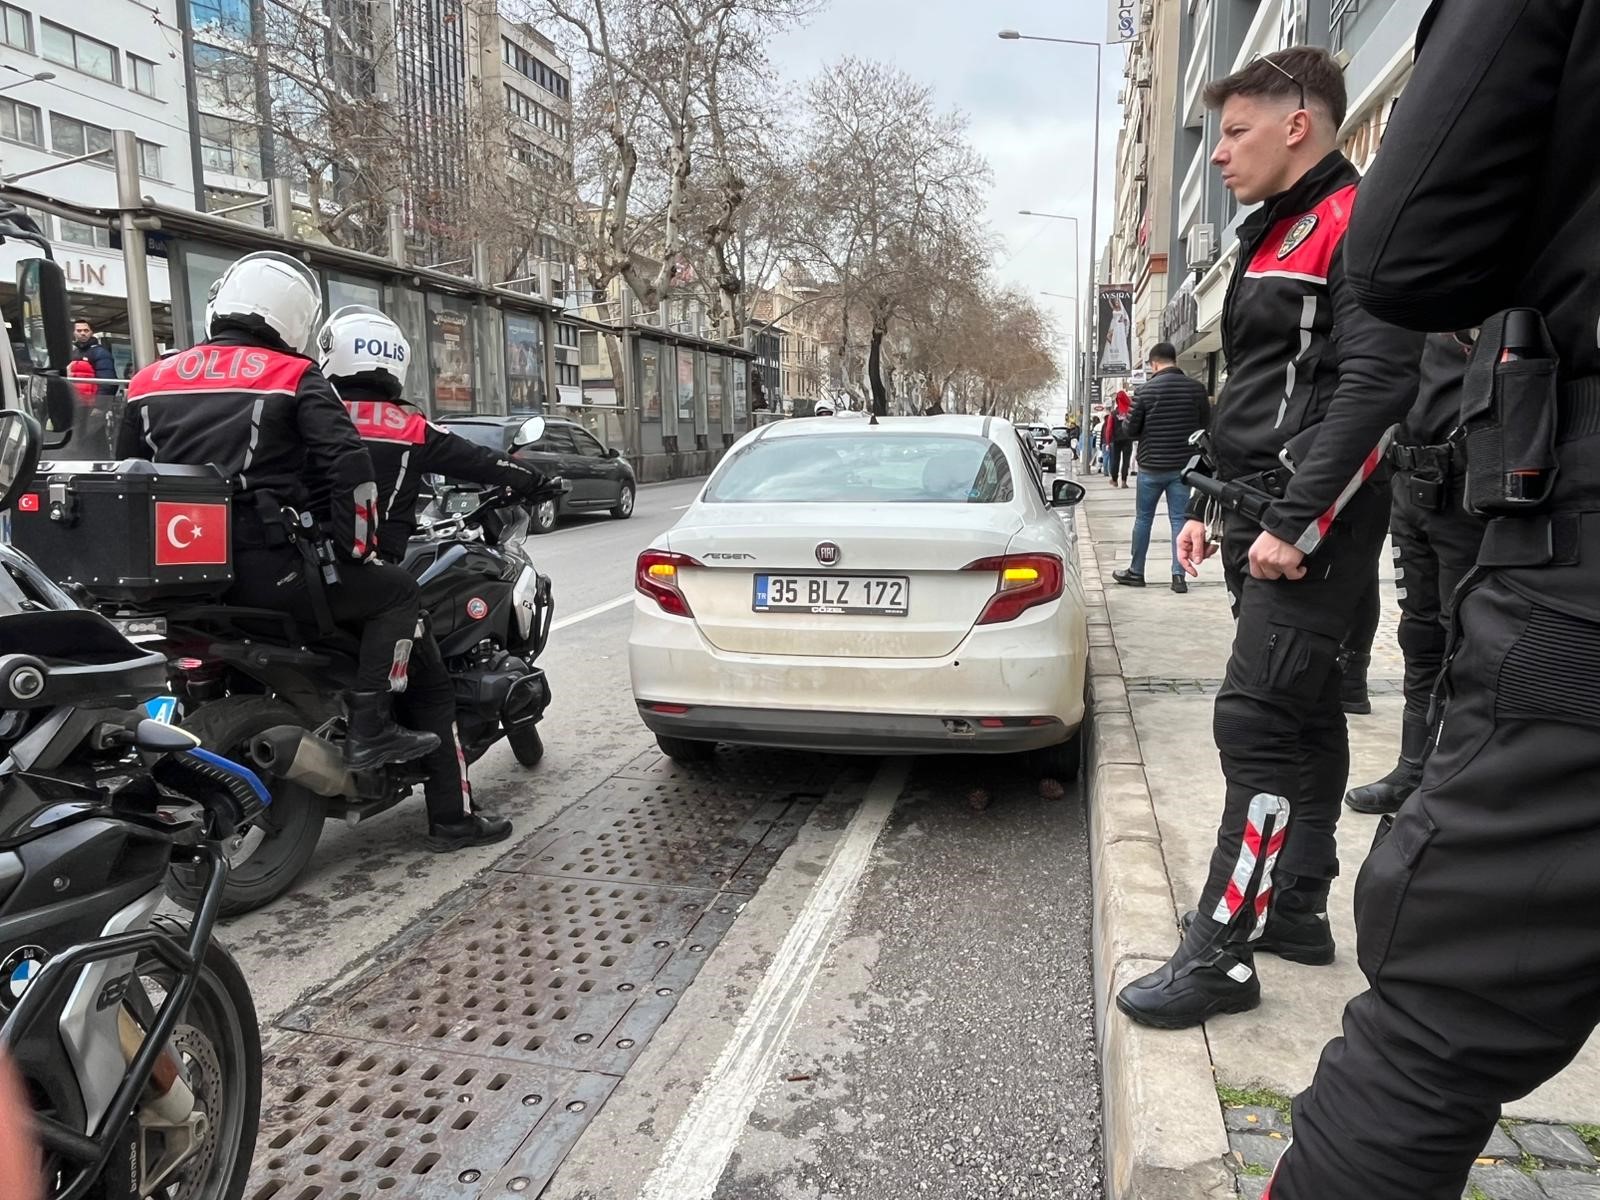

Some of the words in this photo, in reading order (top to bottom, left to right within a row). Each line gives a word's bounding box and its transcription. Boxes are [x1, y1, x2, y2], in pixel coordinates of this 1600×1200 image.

[820, 547, 835, 558] FIAT
[757, 592, 767, 600] TR
[771, 579, 798, 604] 35
[808, 580, 850, 604] BLZ
[863, 581, 903, 606] 172
[128, 1142, 137, 1193] brembo
